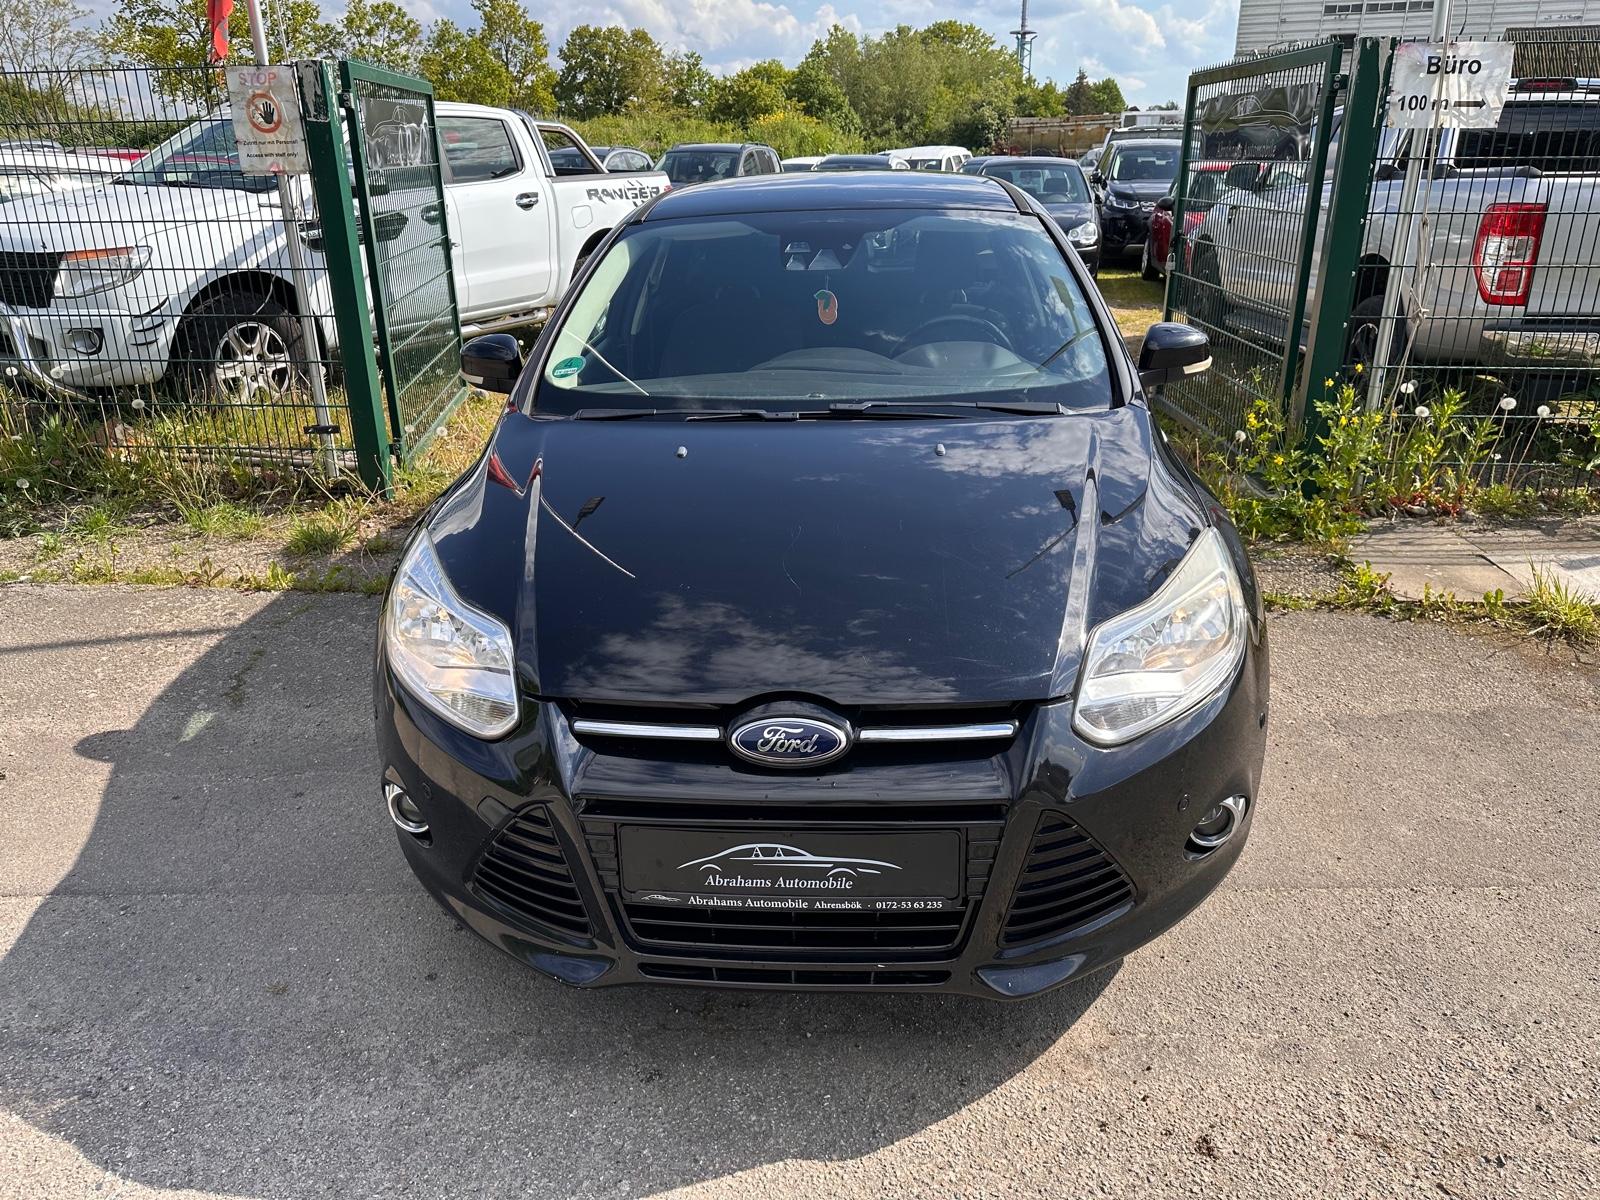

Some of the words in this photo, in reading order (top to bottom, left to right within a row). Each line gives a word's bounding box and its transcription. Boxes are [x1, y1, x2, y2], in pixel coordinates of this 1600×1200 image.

[1426, 55, 1482, 75] Büro
[239, 72, 277, 86] STOP
[1398, 95, 1427, 111] 100
[1431, 98, 1449, 111] m
[586, 184, 660, 205] RANGER
[564, 358, 575, 368] 4
[757, 726, 820, 753] Ford
[704, 874, 772, 888] Abrahams
[774, 876, 853, 889] Automobile
[687, 896, 743, 907] Abrahams
[745, 897, 809, 909] Automobile
[814, 900, 863, 909] Ahrensbök
[875, 901, 912, 909] 0172-53
[913, 901, 925, 909] 63
[926, 901, 943, 909] 235
